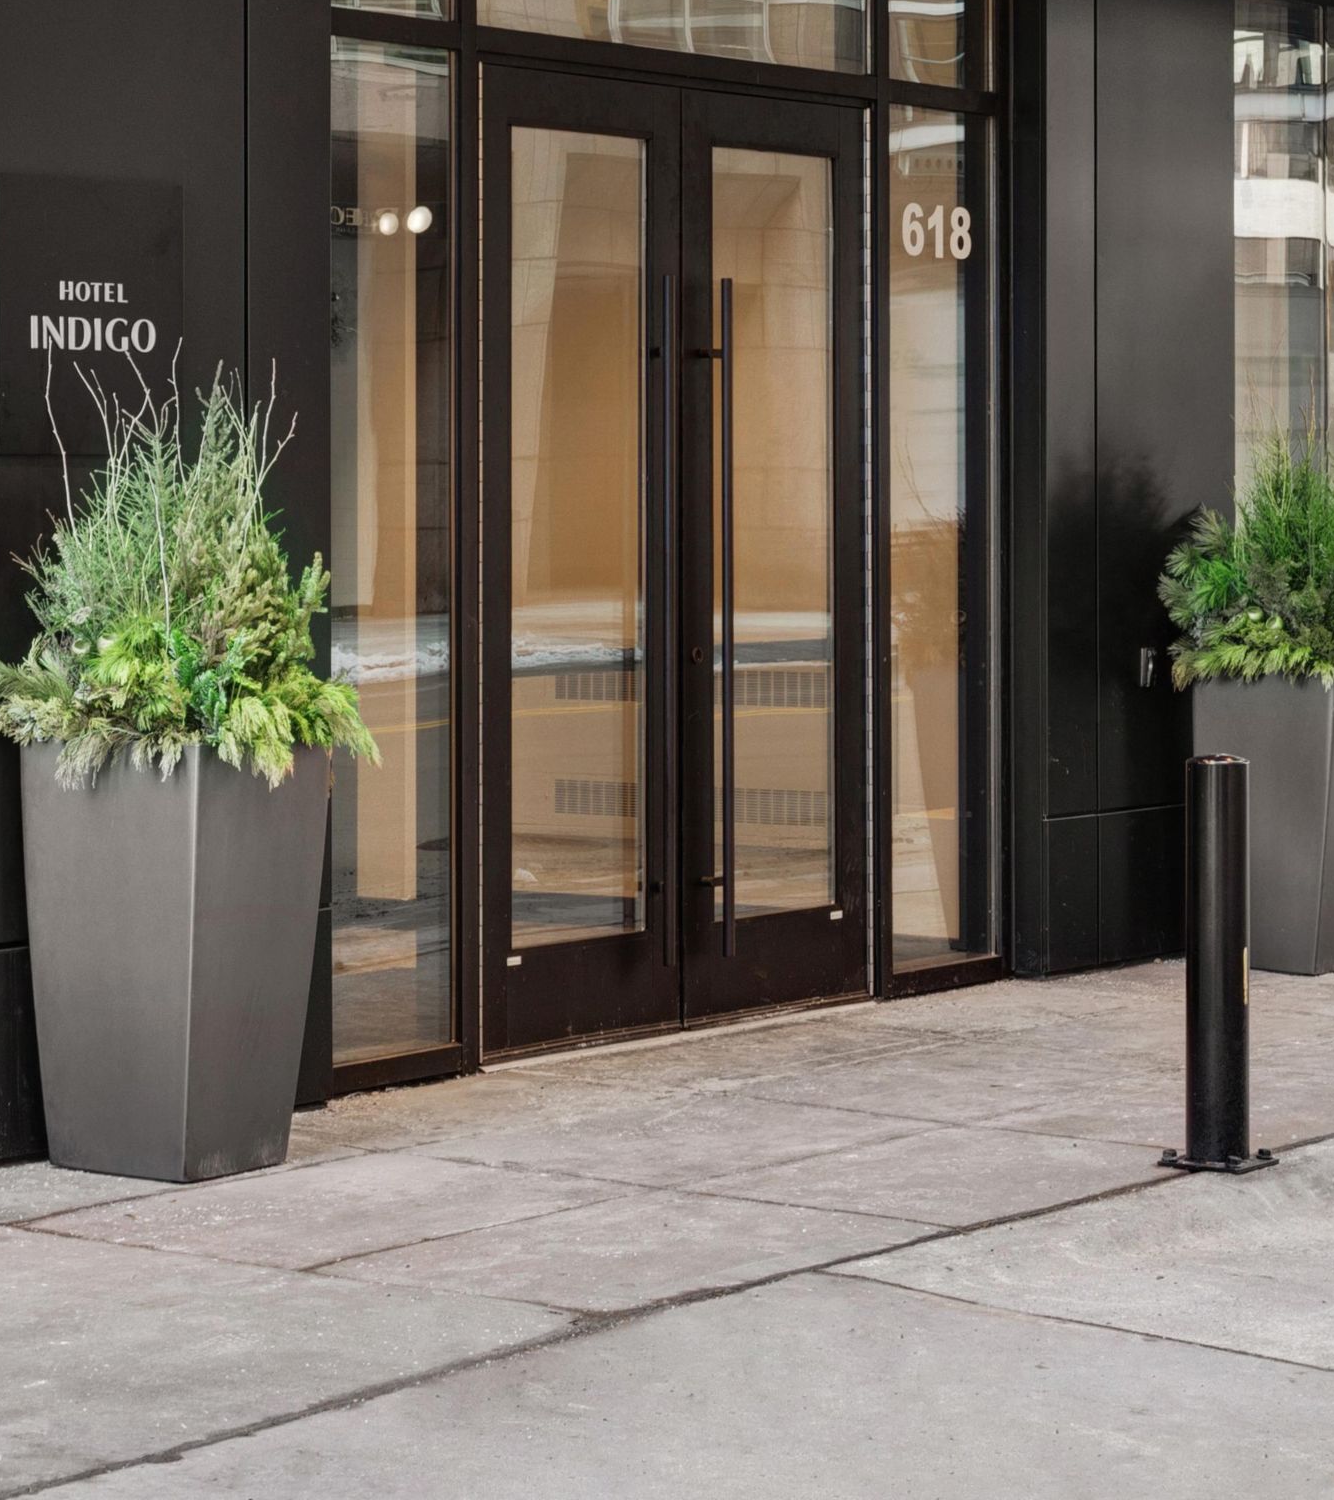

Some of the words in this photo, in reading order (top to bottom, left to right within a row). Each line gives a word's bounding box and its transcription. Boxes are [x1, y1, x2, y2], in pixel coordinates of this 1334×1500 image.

[901, 201, 972, 260] 618
[58, 279, 129, 304] HOTEL
[29, 314, 157, 353] INDIGO
